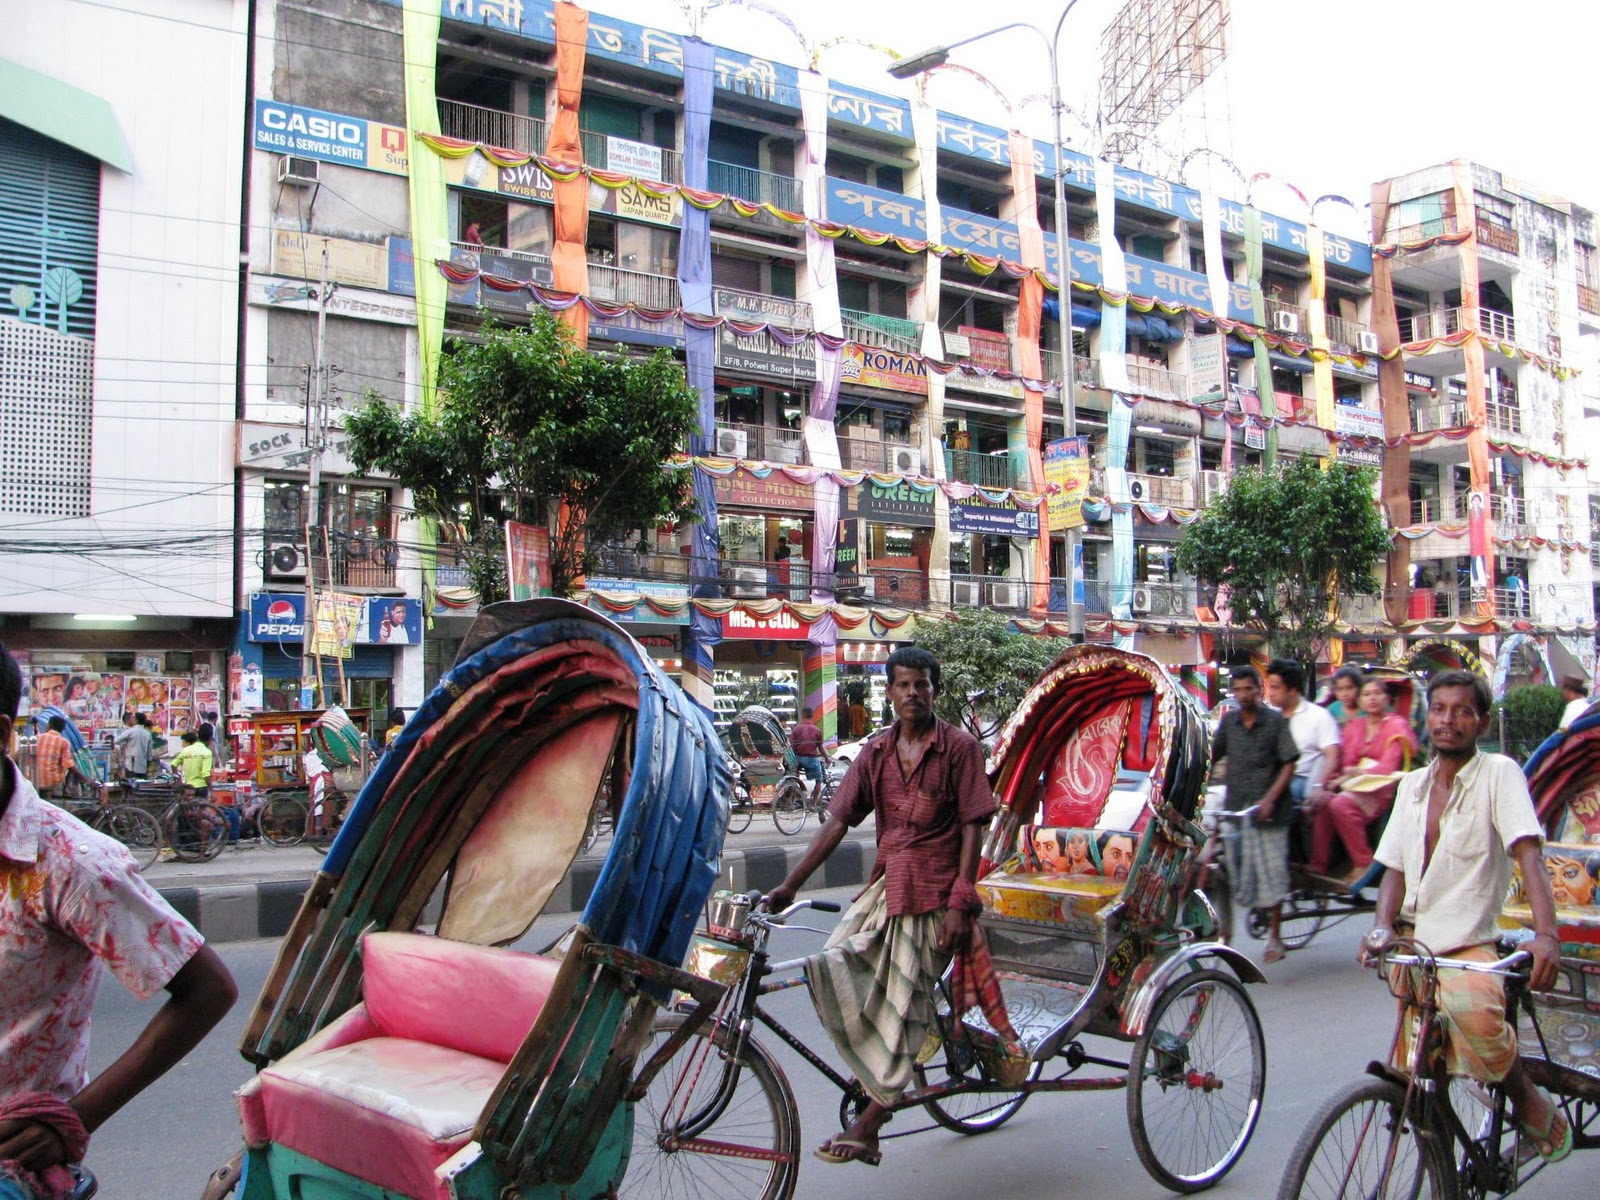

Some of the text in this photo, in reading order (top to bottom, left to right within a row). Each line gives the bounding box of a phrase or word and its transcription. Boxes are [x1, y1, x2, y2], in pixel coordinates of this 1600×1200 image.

[263, 108, 361, 144] CASIO
[257, 130, 363, 161] SALES & SERVICE CENTER
[385, 154, 408, 170] Sup
[502, 165, 553, 191] SWIS
[504, 183, 554, 200] SWISS QU
[621, 186, 671, 213] SAMS
[623, 206, 669, 221] JAPAN QUARTZ
[724, 356, 742, 367] 2F/8,
[770, 363, 792, 375] Super
[795, 366, 816, 377] Marke
[863, 352, 927, 376] ROMAN
[1413, 374, 1431, 388] BOSS
[249, 433, 292, 456] SOCK
[716, 477, 758, 494] ONE
[741, 495, 797, 506] COLLECTION
[871, 485, 935, 504] GREEN
[964, 512, 984, 521] Importer
[837, 548, 856, 563] REEN
[256, 624, 304, 636] PEPSI
[768, 613, 800, 630] CLUB
